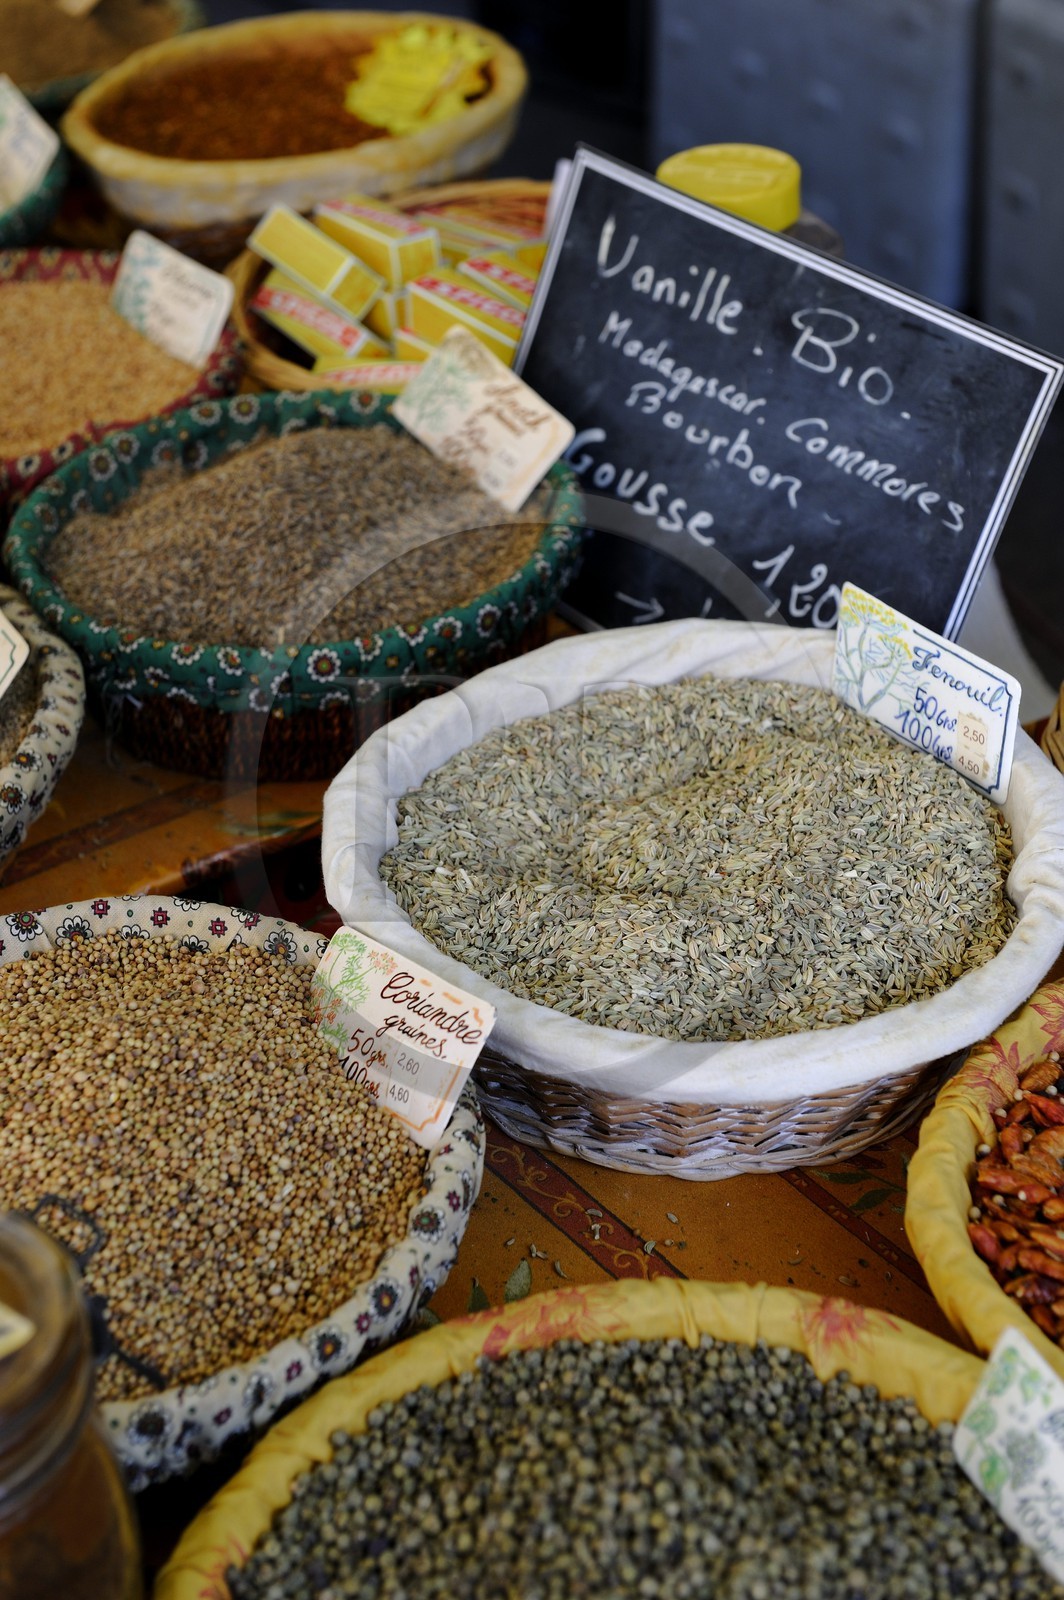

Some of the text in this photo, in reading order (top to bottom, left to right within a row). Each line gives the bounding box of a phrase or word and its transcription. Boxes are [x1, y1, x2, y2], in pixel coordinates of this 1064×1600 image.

[625, 380, 803, 510] Bourbon
[785, 417, 966, 533] Commores
[963, 725, 985, 745] 2,50
[958, 755, 980, 775] 4,50
[380, 971, 483, 1044] Coriandre
[397, 1052, 420, 1075] 2,60
[389, 1084, 410, 1104] 4,60
